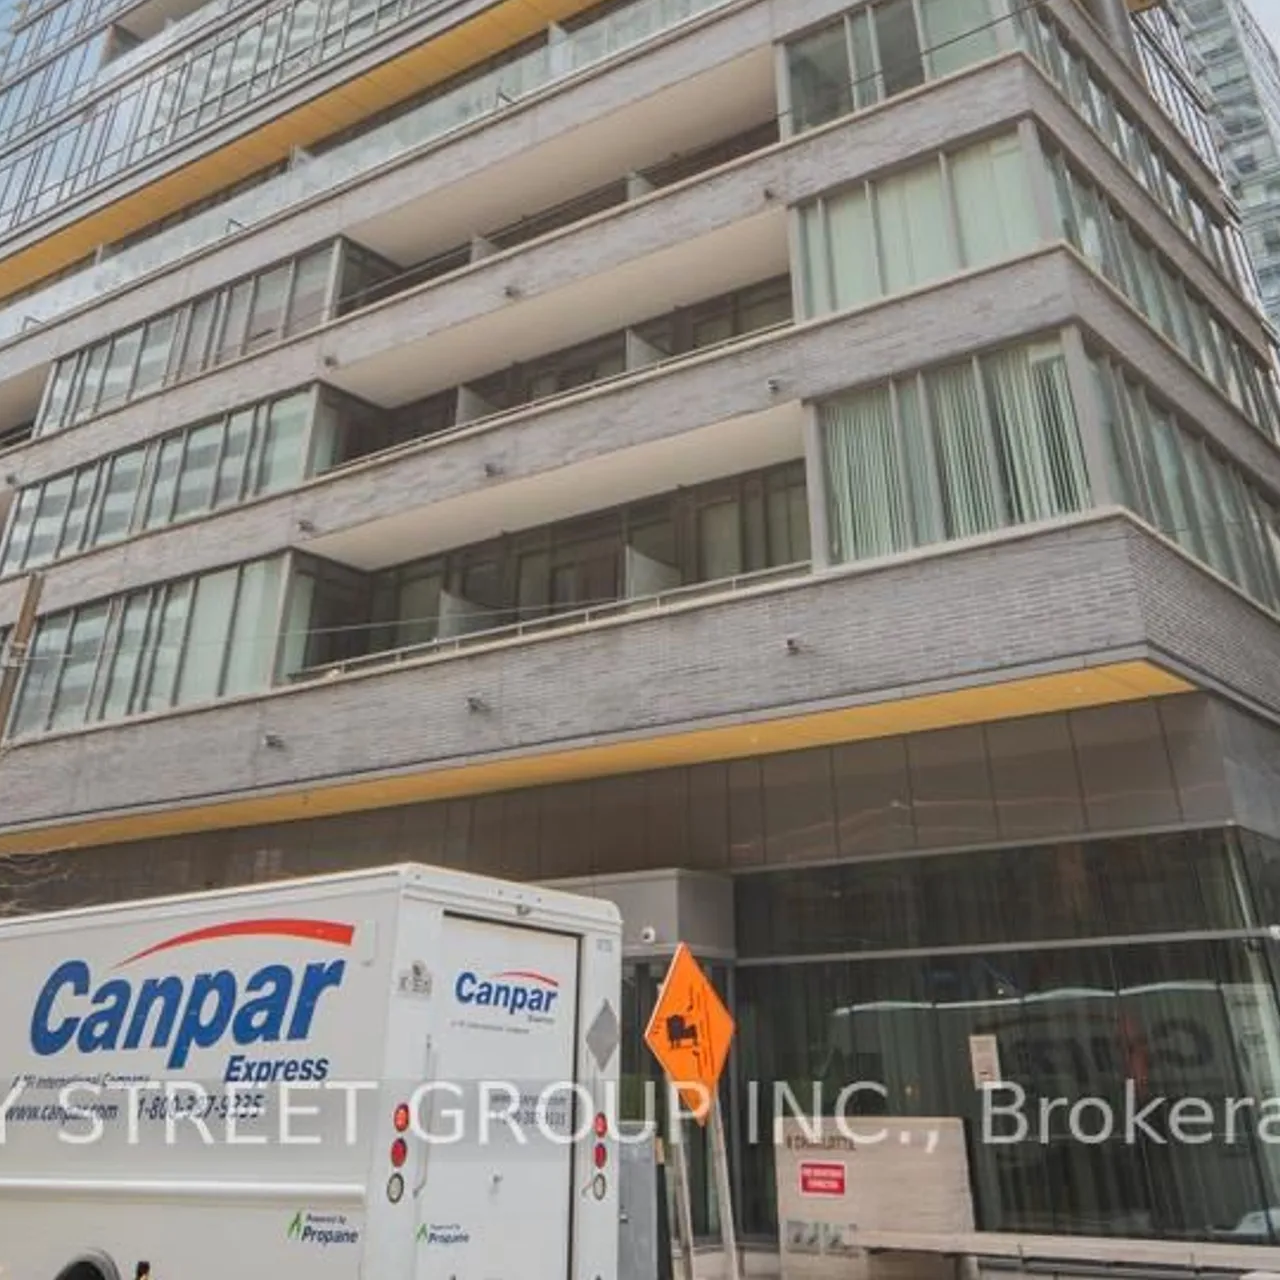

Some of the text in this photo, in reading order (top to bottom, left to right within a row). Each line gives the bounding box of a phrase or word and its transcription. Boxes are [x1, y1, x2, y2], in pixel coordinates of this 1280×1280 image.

[455, 970, 559, 1015] Canpar
[30, 959, 347, 1070] Canpar
[223, 1054, 330, 1084] Express
[301, 1225, 359, 1248] Propane
